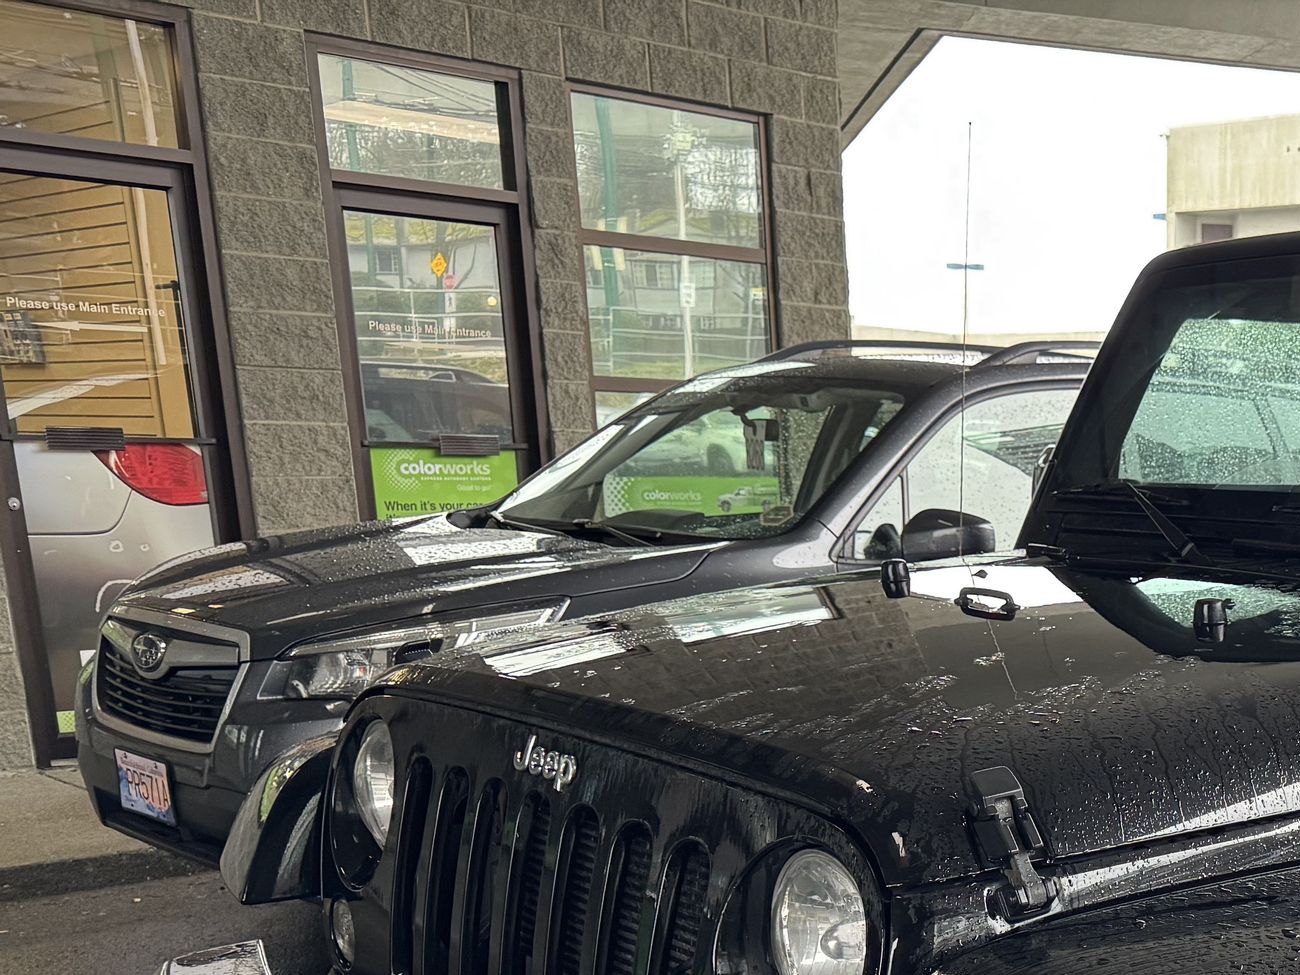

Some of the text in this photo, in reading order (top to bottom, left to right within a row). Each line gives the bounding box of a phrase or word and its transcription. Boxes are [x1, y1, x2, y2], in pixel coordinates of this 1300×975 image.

[5, 296, 166, 317] Please use Main Entrane
[368, 320, 402, 332] Please
[400, 460, 490, 475] colorworks
[384, 501, 418, 511] When
[420, 500, 436, 511] it's
[439, 501, 465, 512] your
[513, 735, 577, 792] Jeep
